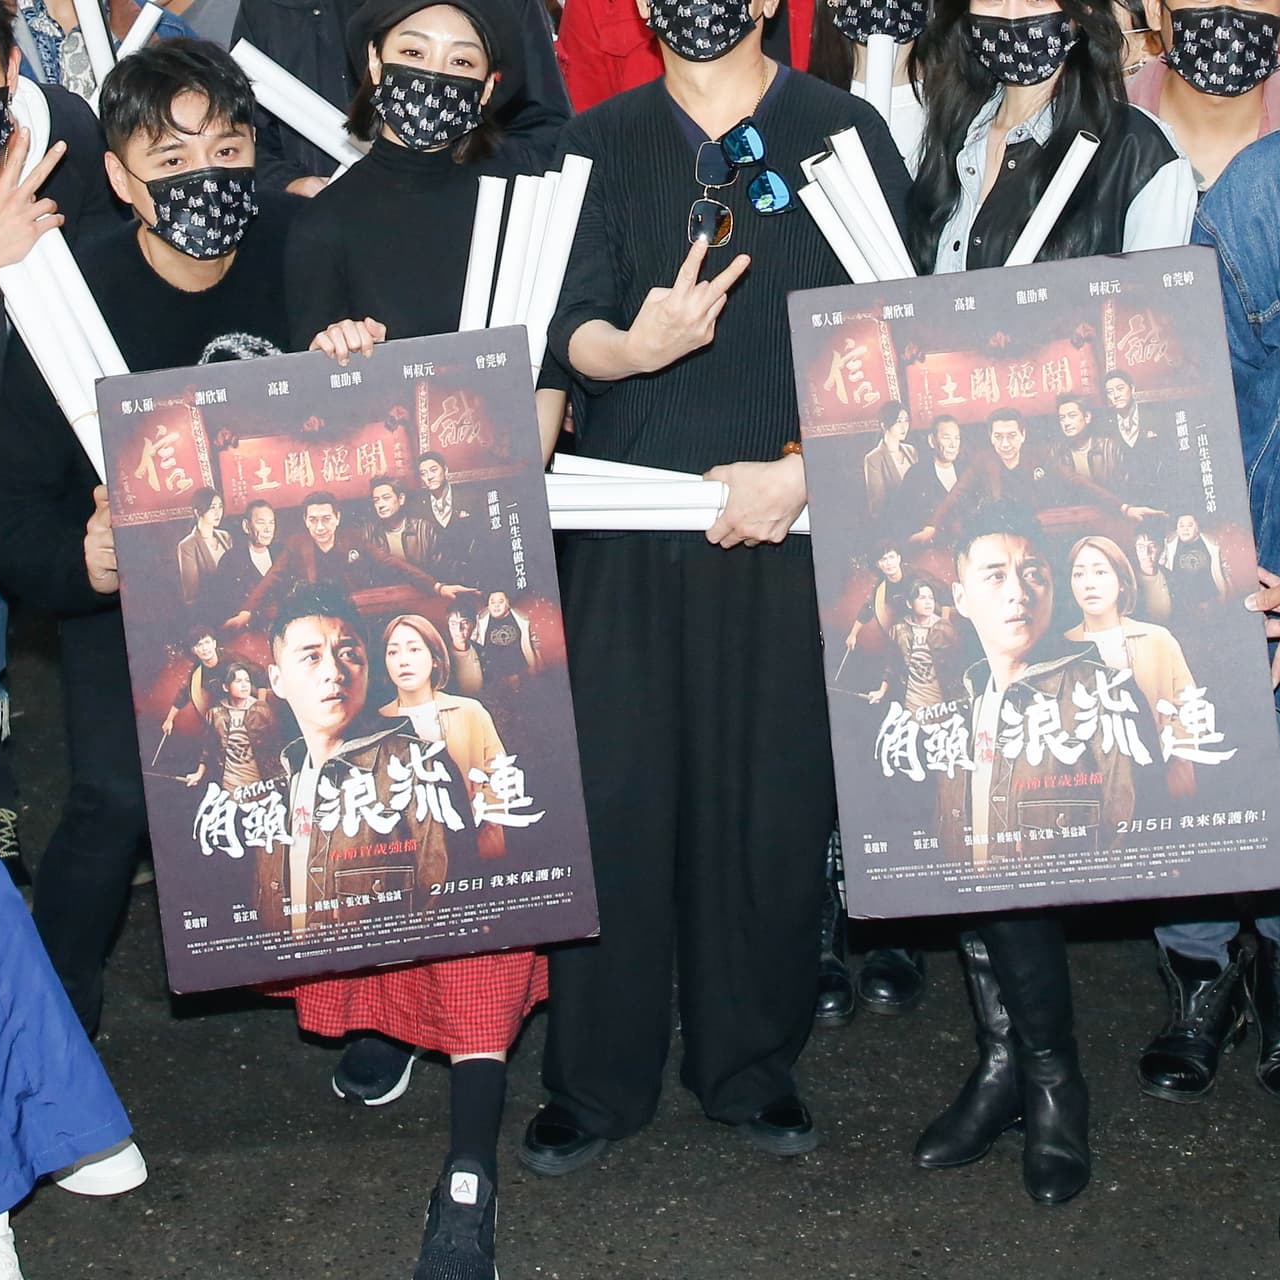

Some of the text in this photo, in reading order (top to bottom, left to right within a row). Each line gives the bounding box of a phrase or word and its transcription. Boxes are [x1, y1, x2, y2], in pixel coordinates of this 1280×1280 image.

[873, 700, 977, 782] 角頭
[1001, 668, 1239, 767] 浪流連
[192, 780, 295, 859] 角頭
[317, 740, 547, 838] 浪流連
[1116, 817, 1174, 834] 2月5日
[429, 876, 484, 898] 2月5日
